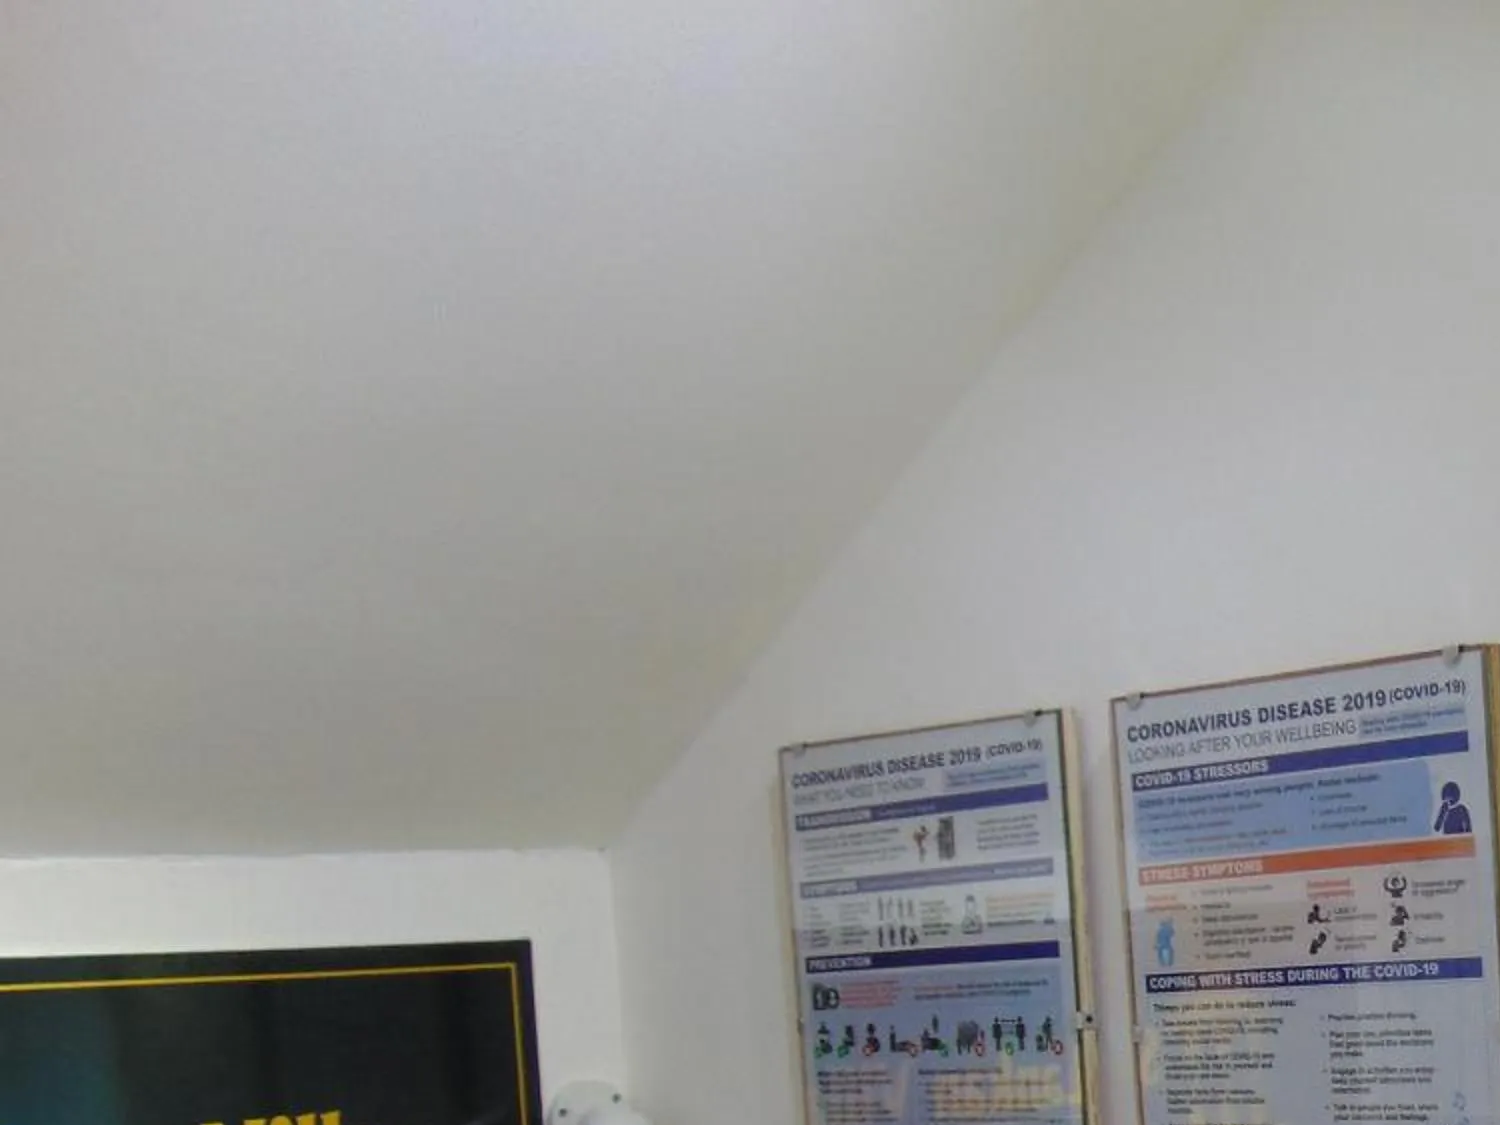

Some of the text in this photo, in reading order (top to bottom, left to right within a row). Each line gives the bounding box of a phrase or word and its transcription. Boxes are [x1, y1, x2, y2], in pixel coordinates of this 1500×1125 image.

[1127, 709, 1251, 742] CORONAVIRUS
[1258, 699, 1337, 724] DISEASE
[1342, 689, 1387, 711] 2019
[1389, 679, 1467, 704] (COVID-19)
[1128, 743, 1185, 764] LOOKING
[1189, 735, 1231, 754] AFTER
[1234, 731, 1272, 748] YOUR
[1276, 719, 1358, 745] WELLBEING
[791, 758, 884, 788] CORONAVIRUS
[887, 752, 945, 773] DISEASE
[950, 750, 981, 765] 2019
[1135, 759, 1269, 788] COVID-19 STRESSORS
[1150, 962, 1439, 990] COPING WITH STRESS DURING THE COVID-19
